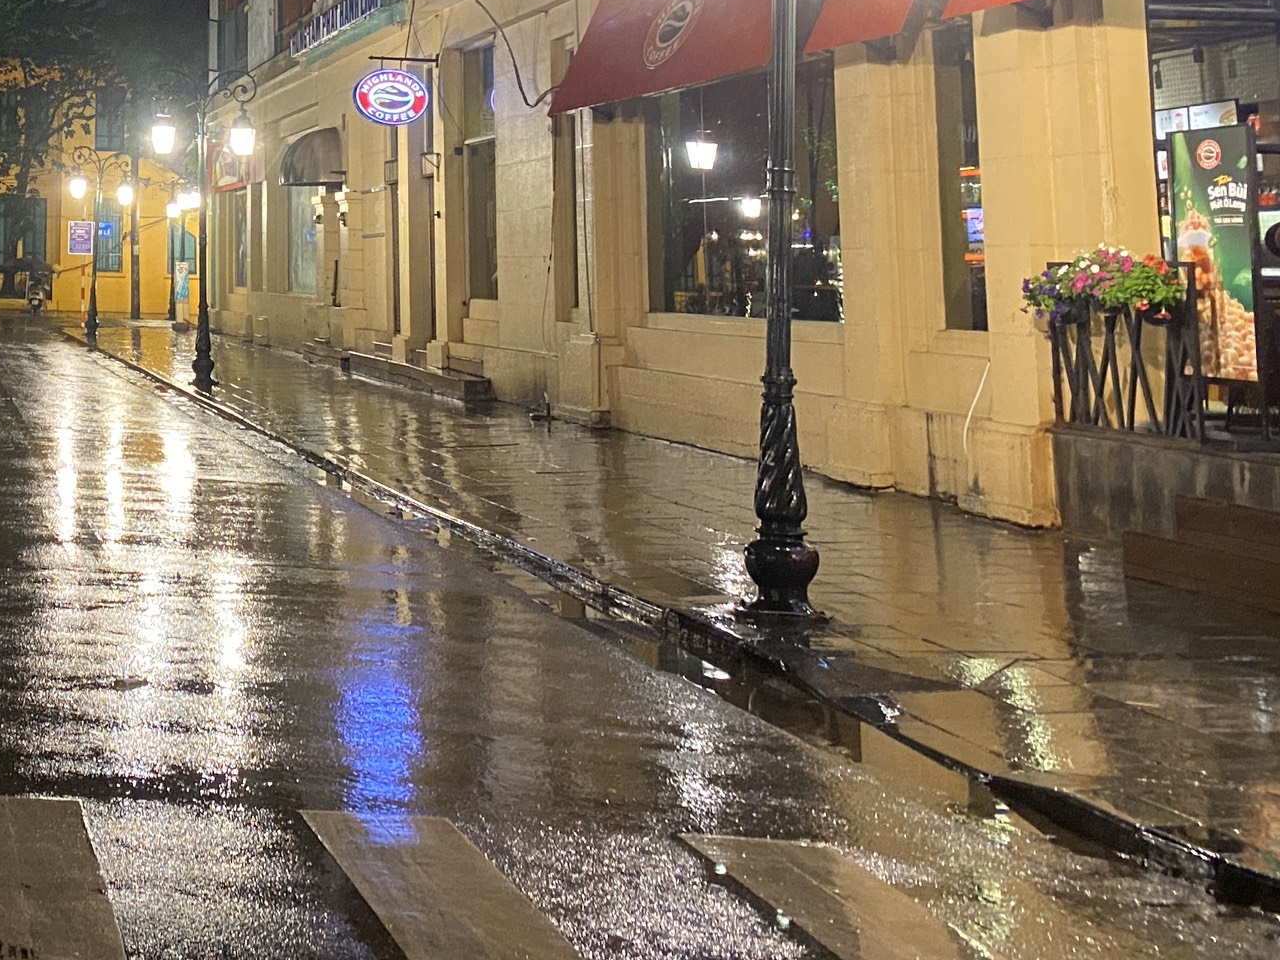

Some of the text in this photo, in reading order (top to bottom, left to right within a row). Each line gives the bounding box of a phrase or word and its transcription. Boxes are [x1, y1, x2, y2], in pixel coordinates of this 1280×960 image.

[361, 73, 424, 97] HIGHLANDS
[367, 106, 417, 121] COFFEE
[1208, 182, 1248, 200] Sen Bùi
